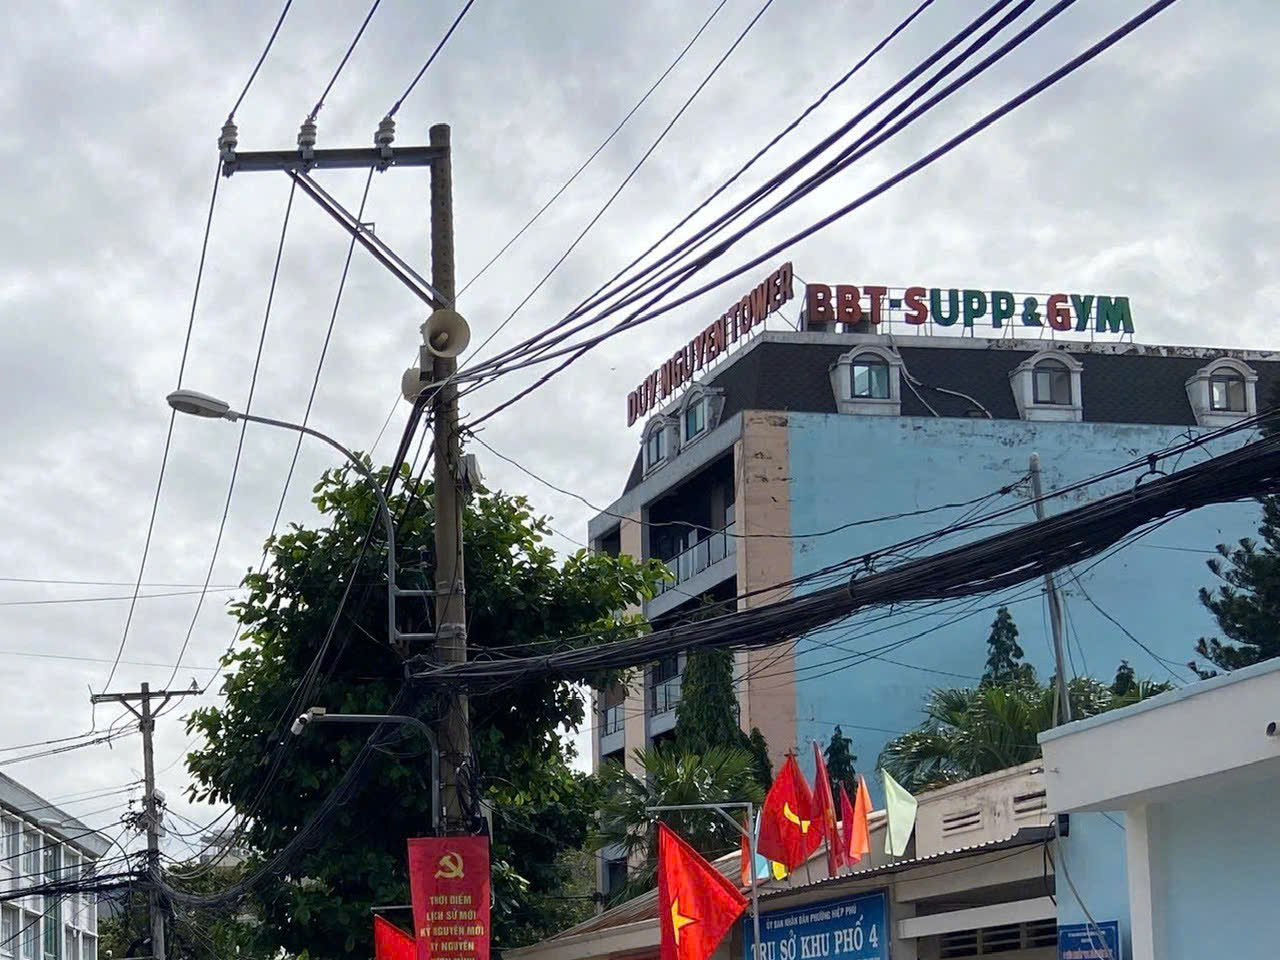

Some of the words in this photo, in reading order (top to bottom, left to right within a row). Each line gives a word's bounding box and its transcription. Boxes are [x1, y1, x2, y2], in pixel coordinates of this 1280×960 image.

[1046, 293, 1134, 333] GYM
[627, 369, 657, 427] DUY
[660, 313, 727, 399] NGUYEN
[728, 262, 794, 343] TOWER
[800, 933, 830, 959] KHU
[834, 915, 864, 955] PHỐ
[869, 923, 879, 948] 4
